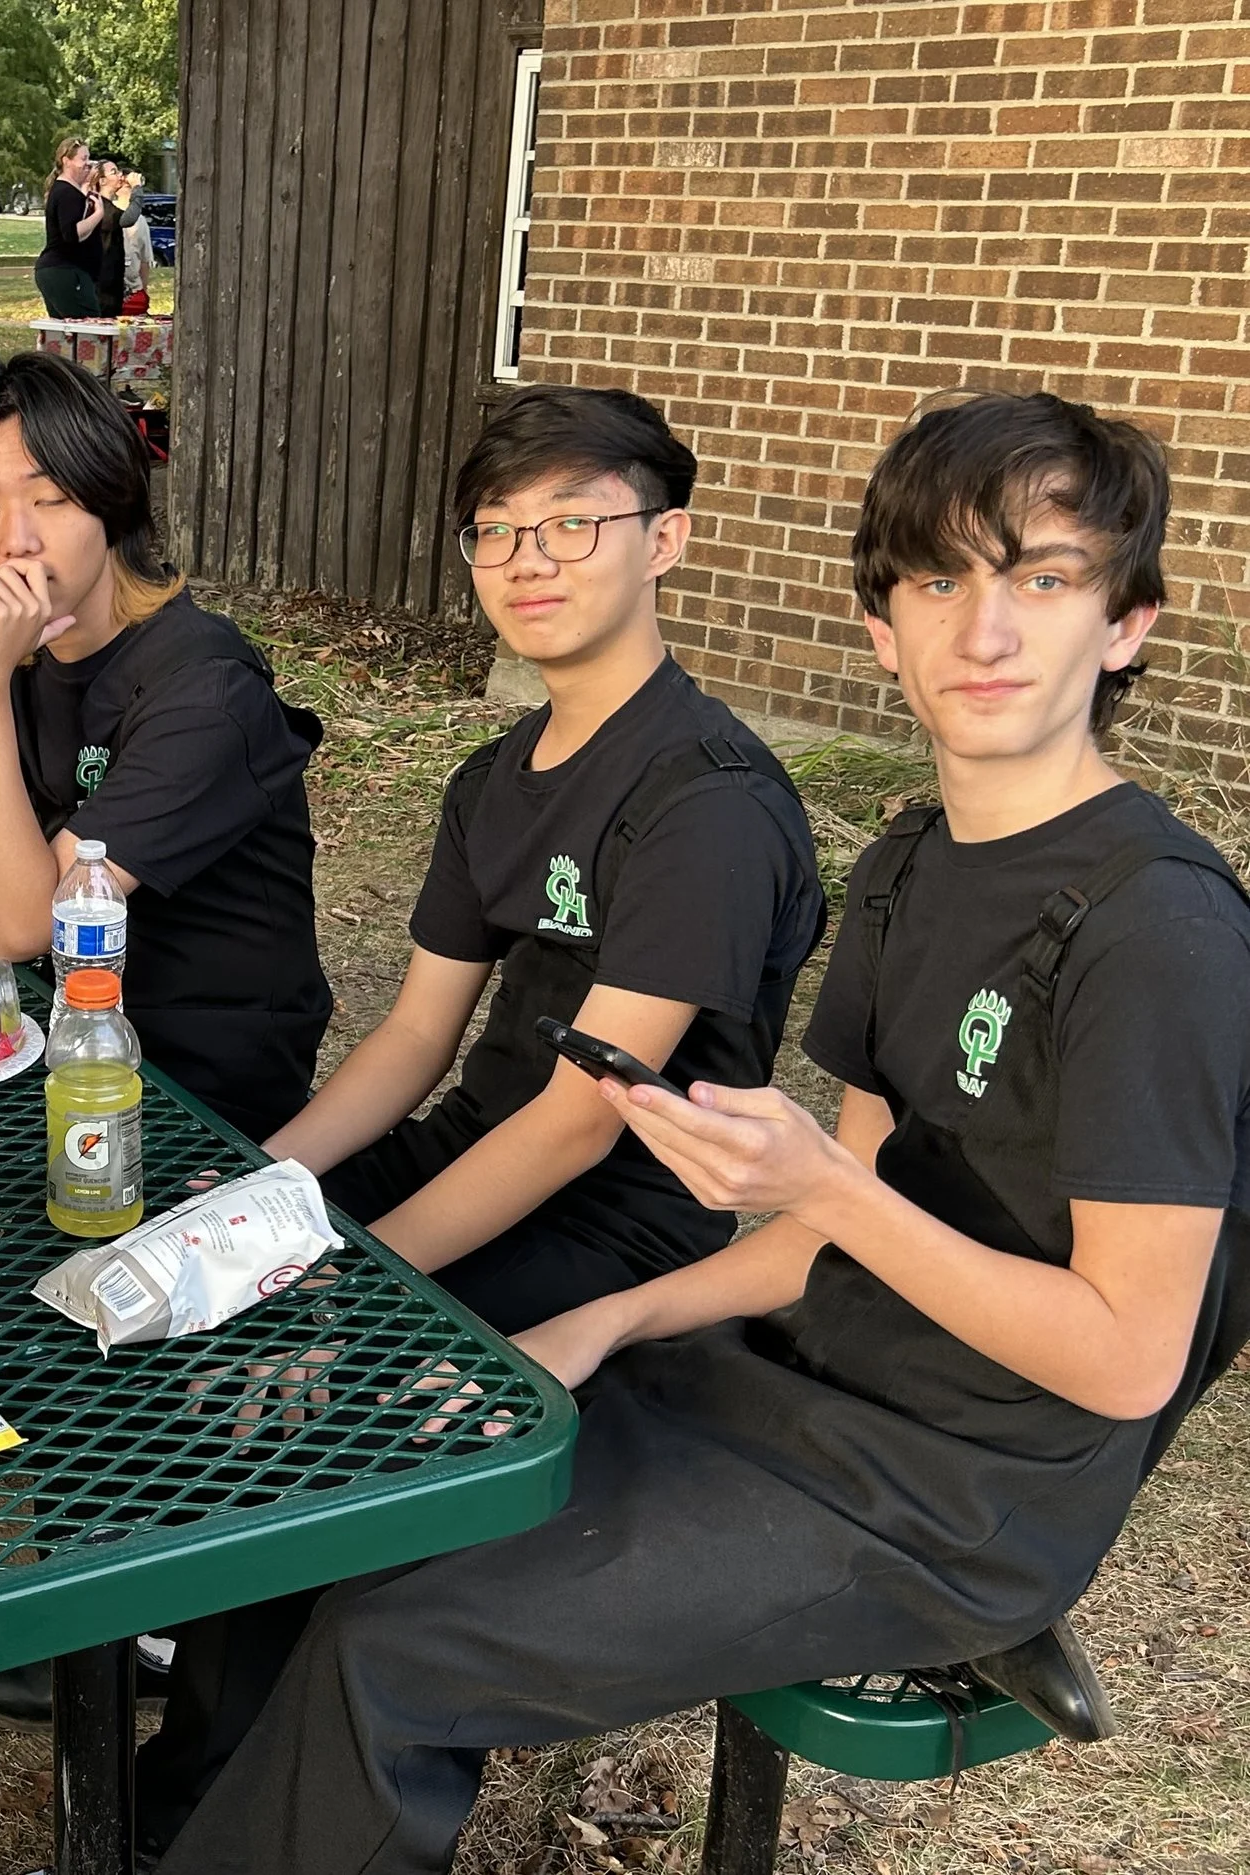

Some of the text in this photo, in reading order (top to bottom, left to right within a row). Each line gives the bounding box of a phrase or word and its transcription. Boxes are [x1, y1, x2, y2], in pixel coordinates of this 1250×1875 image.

[537, 918, 593, 937] BAND
[65, 1121, 109, 1171] G
[289, 1208, 305, 1232] CHIPS
